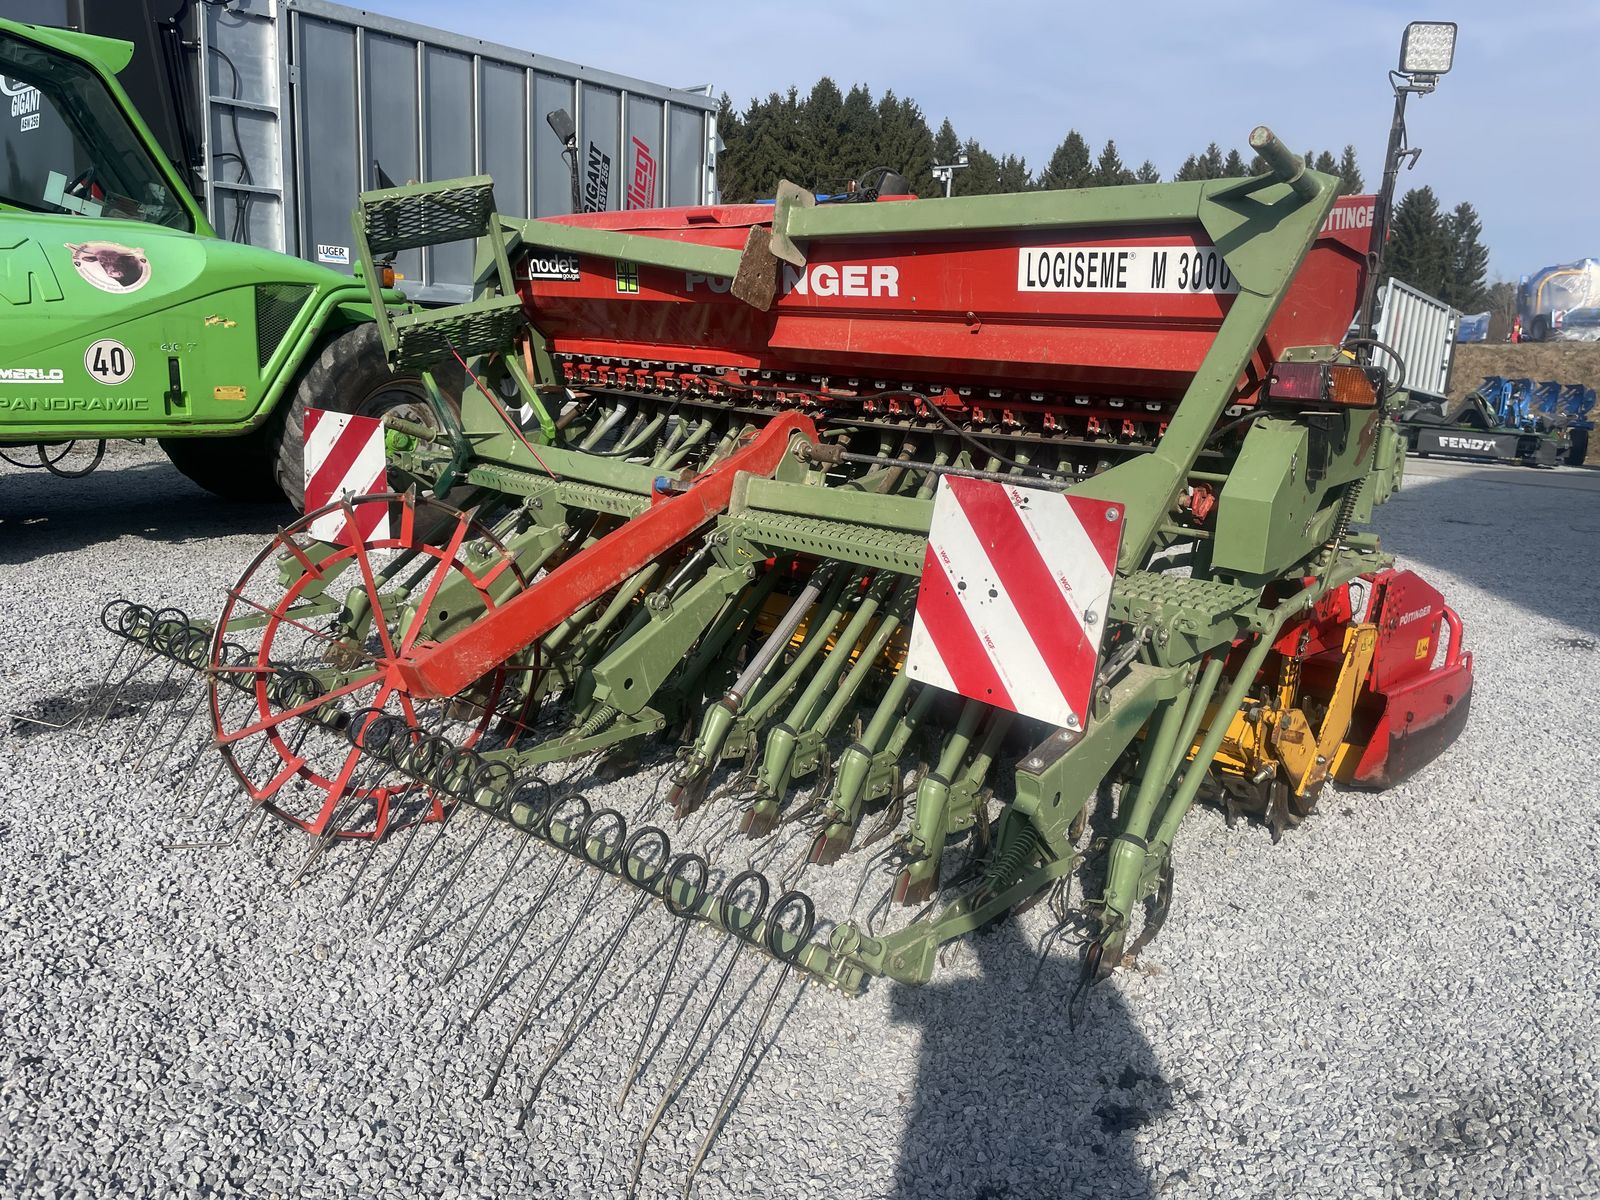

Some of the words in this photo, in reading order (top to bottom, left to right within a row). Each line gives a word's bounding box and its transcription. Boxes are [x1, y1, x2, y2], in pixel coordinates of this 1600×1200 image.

[11, 89, 41, 117] GIGANT
[601, 162, 609, 186] 256
[319, 246, 345, 257] LUGER
[530, 254, 578, 273] nodet
[1151, 252, 1167, 289] M
[1178, 252, 1231, 290] 3000
[93, 347, 126, 376] 40
[0, 368, 64, 380] MERLO
[1438, 436, 1496, 451] FENDT
[940, 550, 951, 565] WGF
[1060, 576, 1073, 592] WGF
[984, 634, 996, 651] WGF
